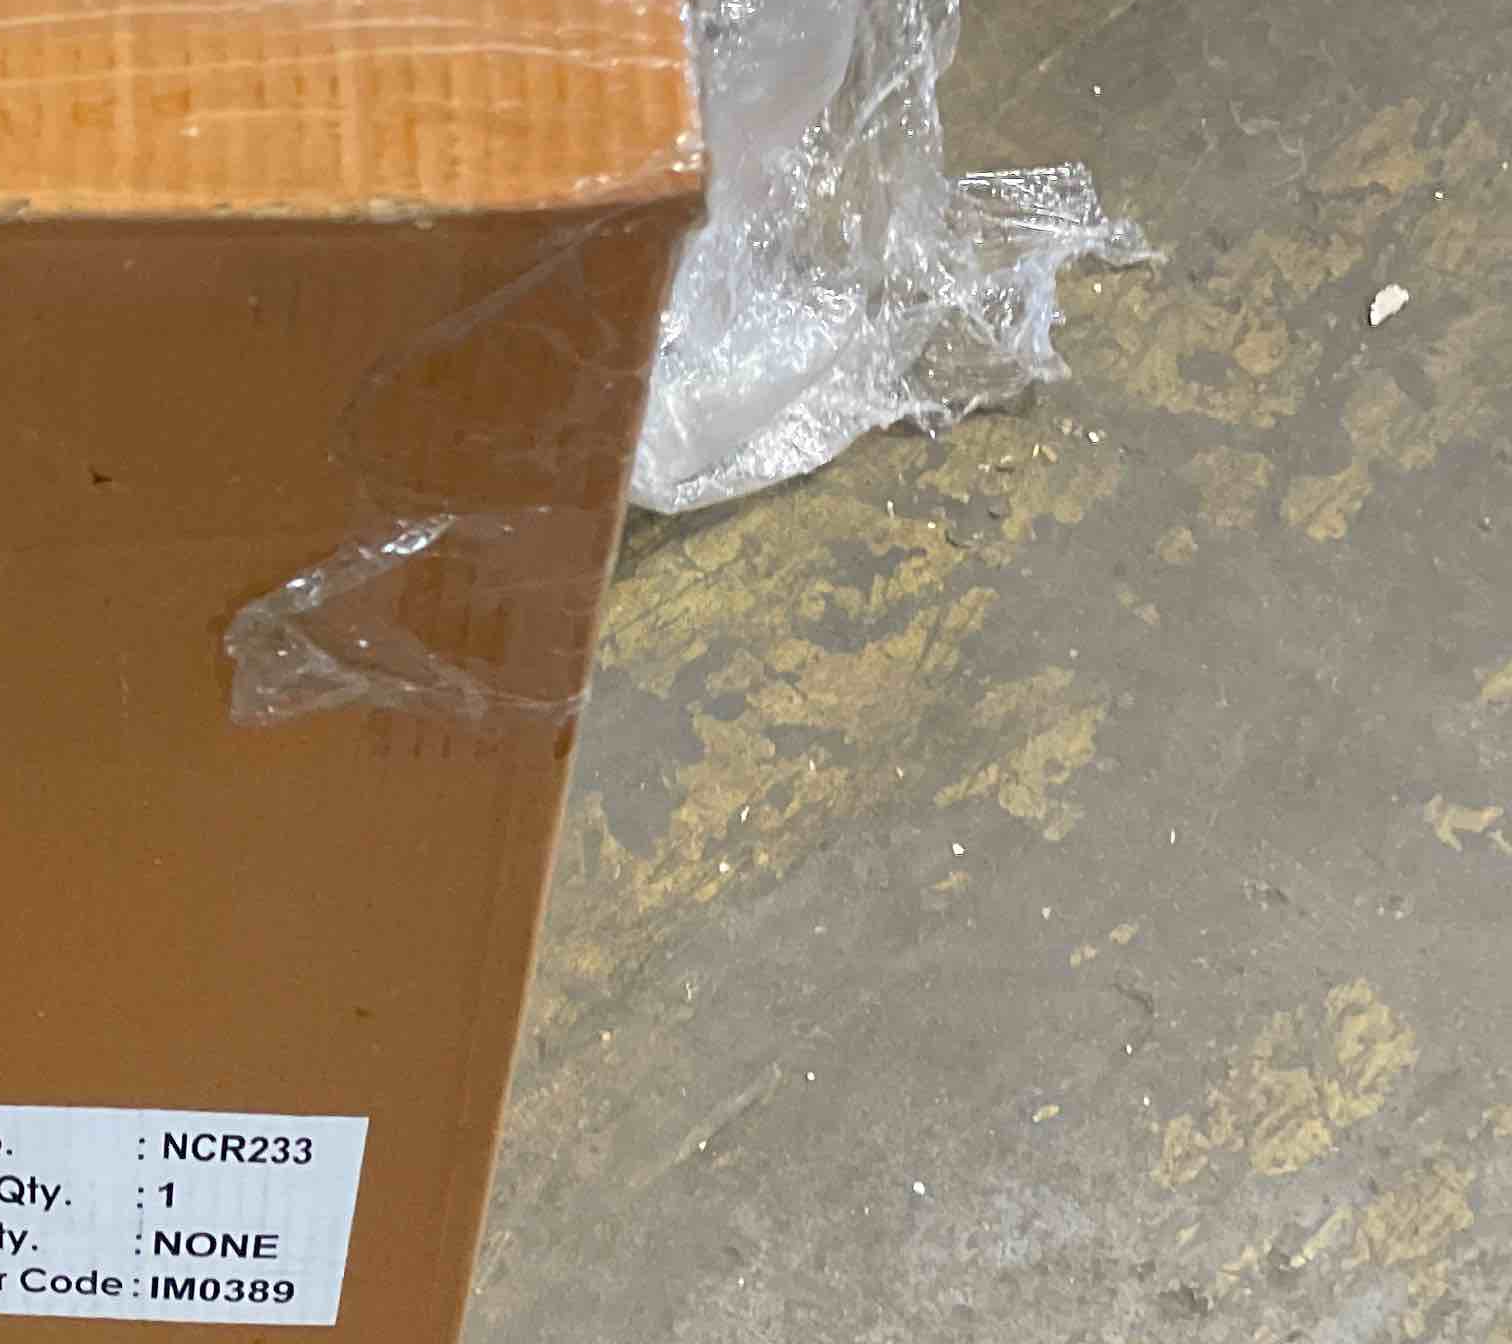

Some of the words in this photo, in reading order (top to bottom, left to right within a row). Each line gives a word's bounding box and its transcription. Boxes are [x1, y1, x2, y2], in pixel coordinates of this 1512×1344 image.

[163, 1132, 313, 1165] NCR233
[158, 1182, 174, 1209] 1
[153, 1230, 279, 1259] NONE
[19, 1267, 123, 1297] Code
